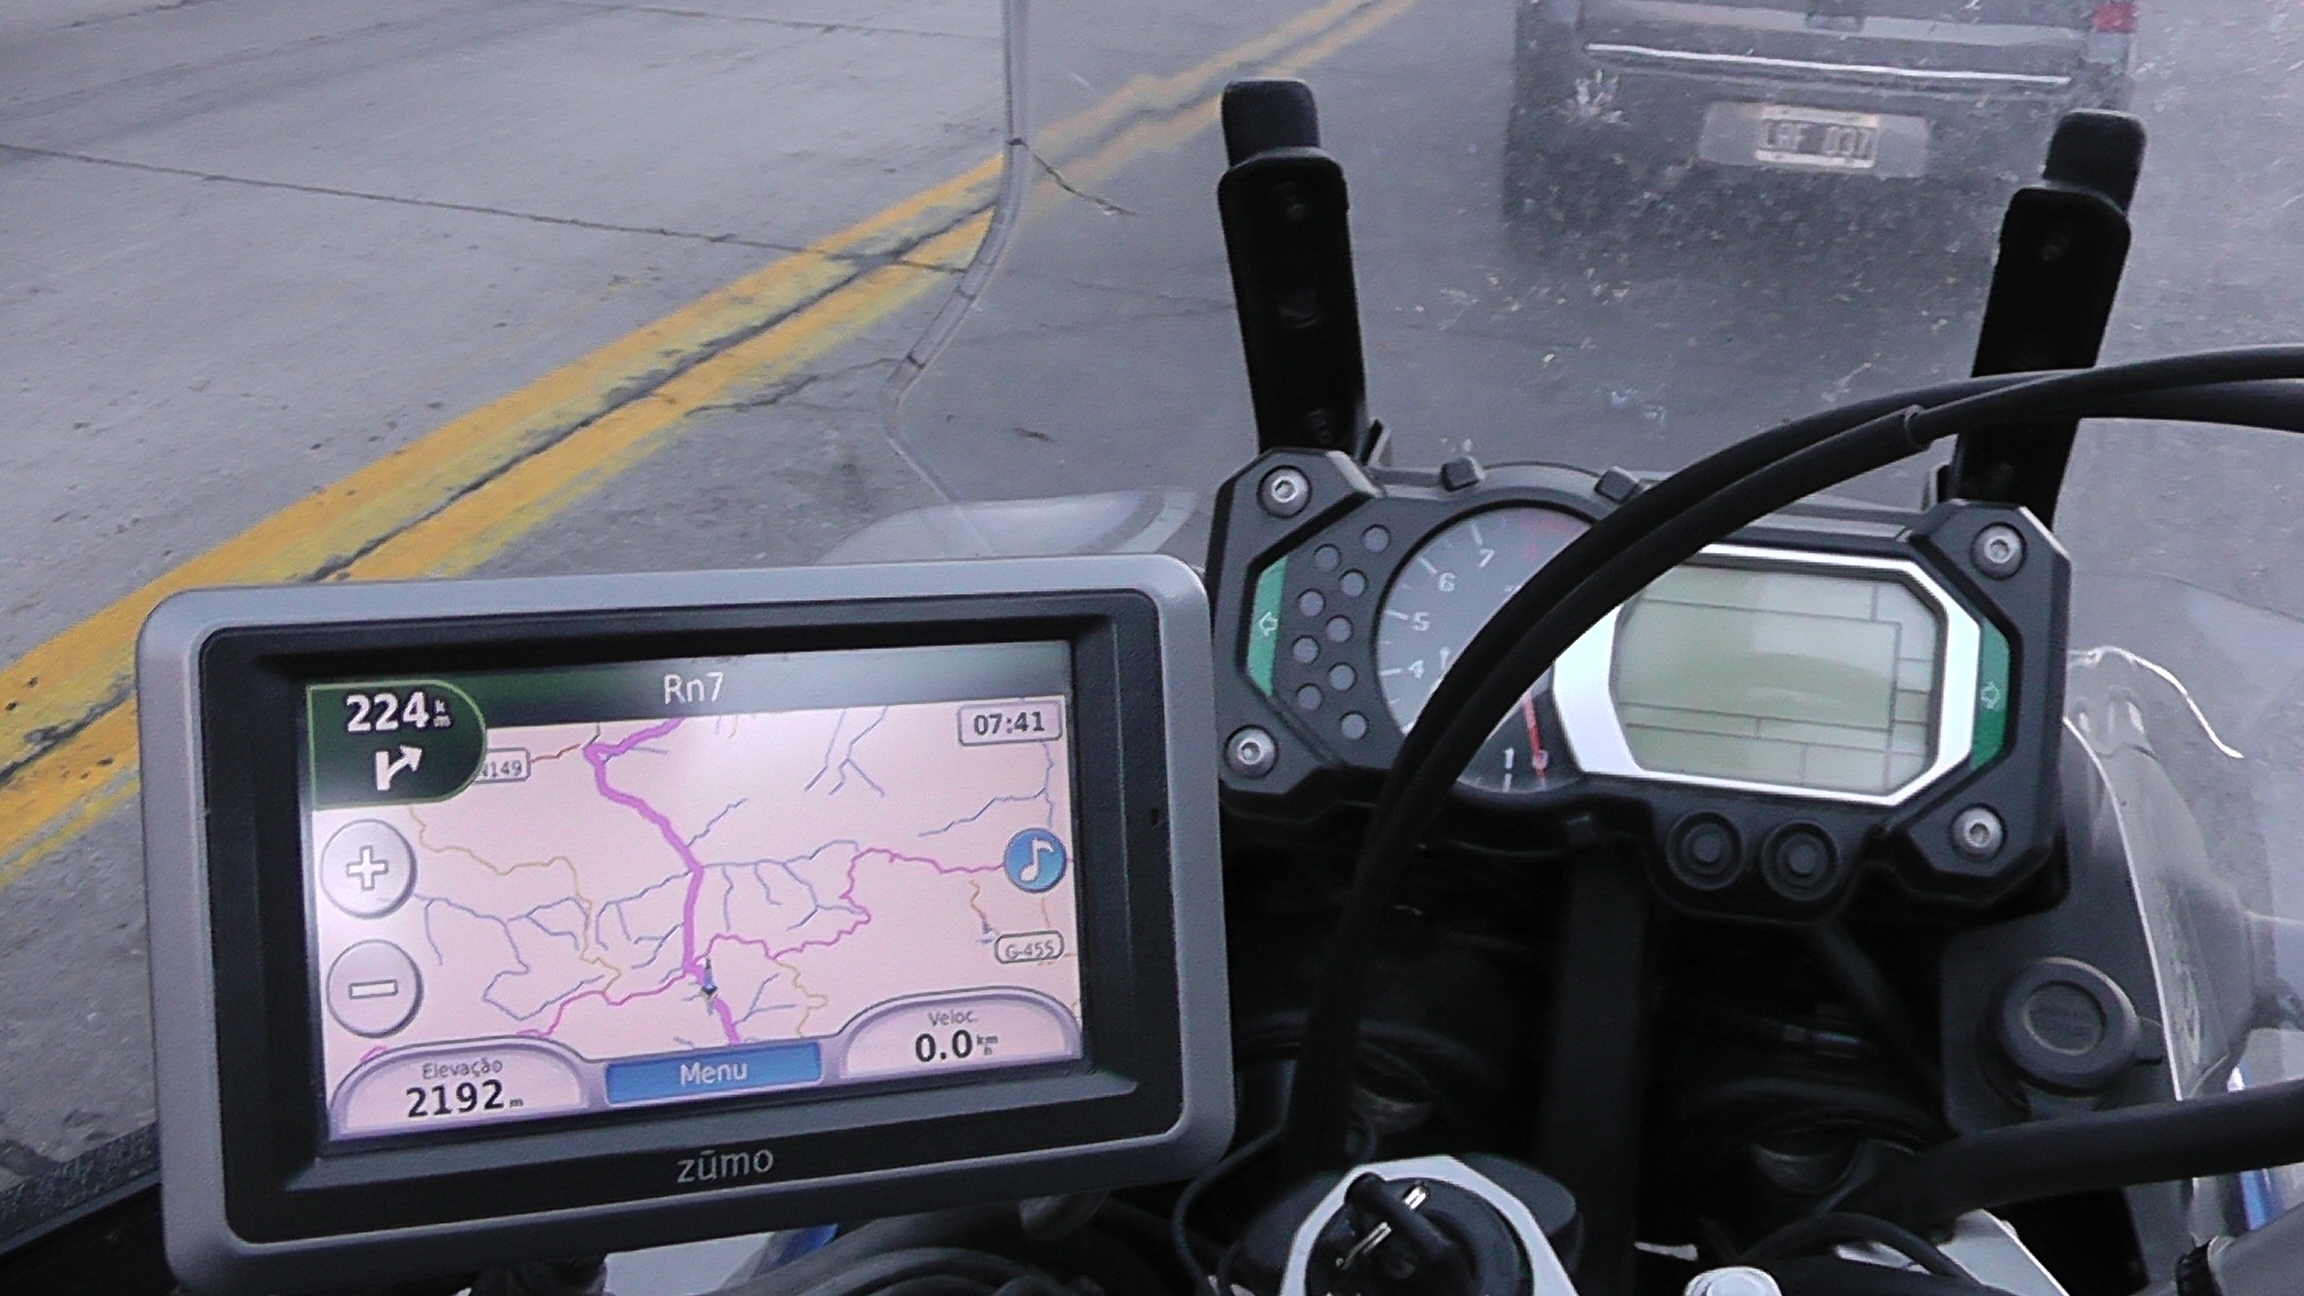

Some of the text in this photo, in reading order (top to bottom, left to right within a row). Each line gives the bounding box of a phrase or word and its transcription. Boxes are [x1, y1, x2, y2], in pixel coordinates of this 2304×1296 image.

[1479, 548, 1495, 568] 7
[1438, 572, 1456, 592] 6
[1413, 612, 1430, 631] 5
[1408, 659, 1424, 679] 4
[663, 671, 724, 705] Rn7
[346, 691, 430, 732] 224
[973, 711, 1046, 736] 07:41
[1504, 747, 1514, 769] 1
[915, 1030, 973, 1062] 0.0
[422, 1057, 503, 1081] Elevação
[680, 1061, 749, 1087] Menu
[406, 1079, 505, 1118] 2192
